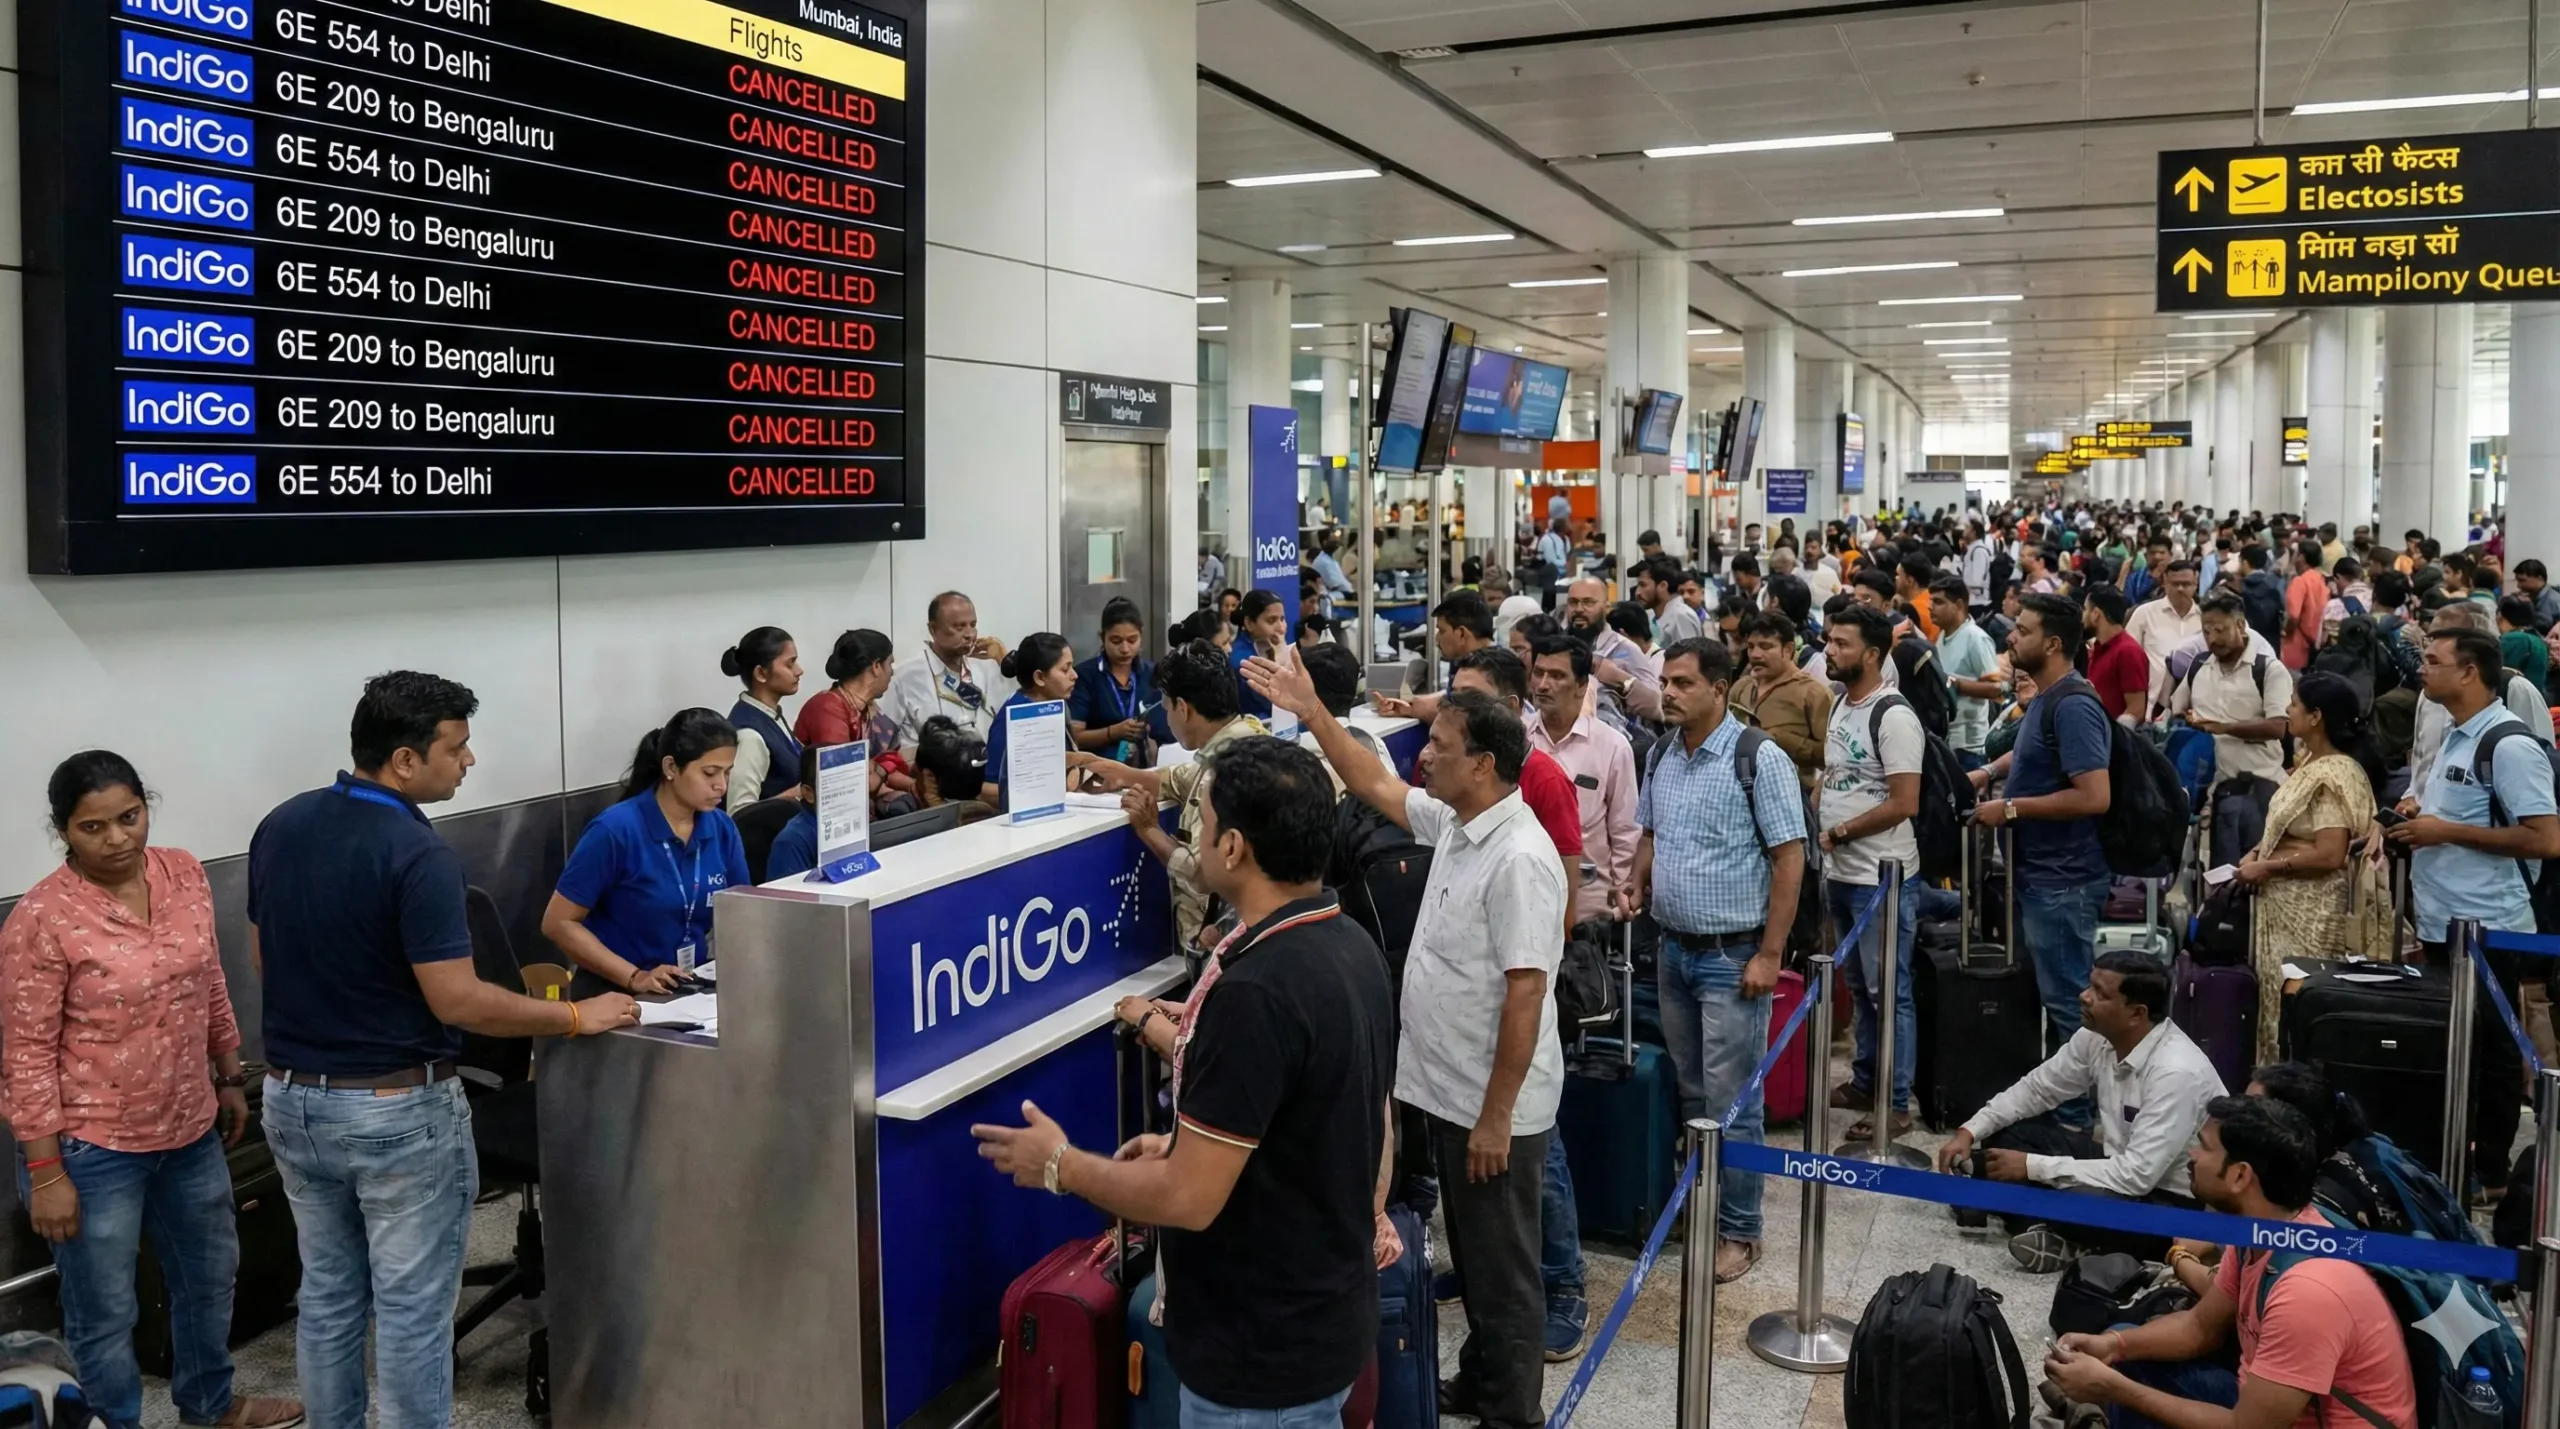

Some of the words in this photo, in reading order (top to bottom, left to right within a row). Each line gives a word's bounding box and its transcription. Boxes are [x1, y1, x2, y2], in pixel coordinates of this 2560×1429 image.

[126, 0, 248, 30] iGo
[424, 0, 491, 26] Delhi
[798, 0, 865, 40] Mumbai,
[867, 18, 903, 49] India
[276, 8, 317, 45] 6E
[327, 19, 381, 58] 554
[388, 34, 415, 65] to
[424, 41, 490, 83] Delhi
[729, 16, 804, 63] Flights
[127, 39, 249, 94] IndiGo
[276, 71, 317, 106] 6E
[326, 81, 381, 117] 209
[388, 94, 415, 124] to
[424, 99, 554, 151] Bengaluru
[729, 64, 876, 125] CANCELLED
[127, 106, 249, 157] IndiGo
[729, 112, 876, 170] CANCELLED
[276, 133, 318, 168] 6E
[327, 141, 381, 178] 554
[388, 153, 415, 183] to
[424, 157, 490, 196] Delhi
[2352, 144, 2384, 173] सी
[127, 173, 249, 221] IndiGo
[728, 161, 876, 214] CANCELLED
[2299, 182, 2464, 211] Electosists
[276, 196, 318, 230] 6E
[327, 202, 381, 237] 209
[389, 212, 416, 242] to
[425, 216, 554, 261] Bengaluru
[728, 210, 876, 260] CANCELLED
[127, 242, 249, 288] IndiGo
[276, 260, 318, 293] 6E
[327, 265, 382, 300] 554
[389, 273, 416, 303] to
[425, 276, 491, 311] Delhi
[728, 259, 876, 304] CANCELLED
[2298, 267, 2470, 296] Mampilony
[128, 315, 250, 357] IndiGo
[728, 309, 876, 351] CANCELLED
[277, 328, 318, 361] 6E
[327, 332, 382, 365] 209
[389, 338, 416, 367] to
[425, 339, 555, 379] Bengaluru
[728, 361, 876, 399] CANCELLED
[128, 388, 250, 426] IndiGo
[278, 396, 319, 428] 6E
[328, 398, 382, 430] 209
[390, 402, 416, 431] to
[425, 402, 555, 440] Bengaluru
[728, 414, 875, 447] CANCELLED
[129, 461, 251, 496] IndiGo
[278, 464, 319, 496] 6E
[329, 465, 383, 495] 554
[390, 467, 417, 495] to
[426, 466, 492, 495] Delhi
[728, 466, 875, 496] CANCELLED
[911, 895, 1091, 1034] IndiGo
[1784, 1153, 1858, 1185] IndiGo
[2252, 1222, 2338, 1254] IndiGo
